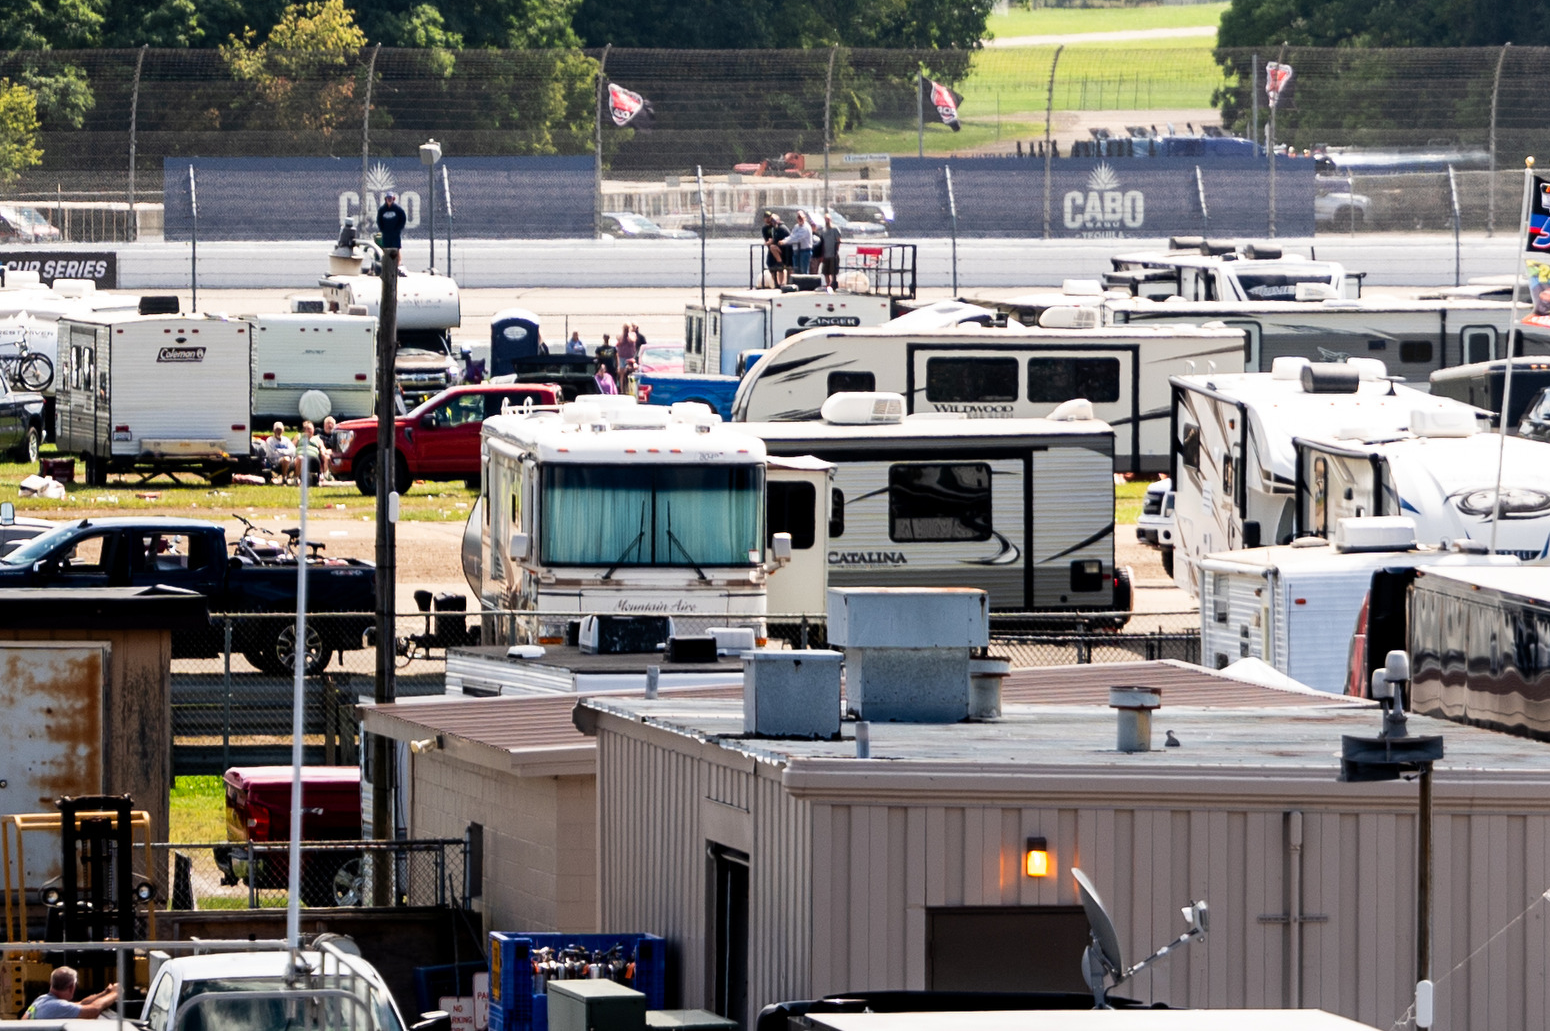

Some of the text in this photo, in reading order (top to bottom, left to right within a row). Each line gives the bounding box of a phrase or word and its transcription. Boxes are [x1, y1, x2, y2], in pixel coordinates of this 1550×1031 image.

[339, 191, 421, 229] CAO
[1063, 190, 1144, 228] CABO
[43, 260, 107, 278] SERIES
[803, 316, 856, 326] ZINGER
[160, 348, 195, 360] Coleman
[933, 404, 1014, 412] WILDWOOD
[828, 551, 907, 564] CATALINA
[614, 598, 697, 611] Mountain Aire
[451, 1016, 472, 1024] RKING
